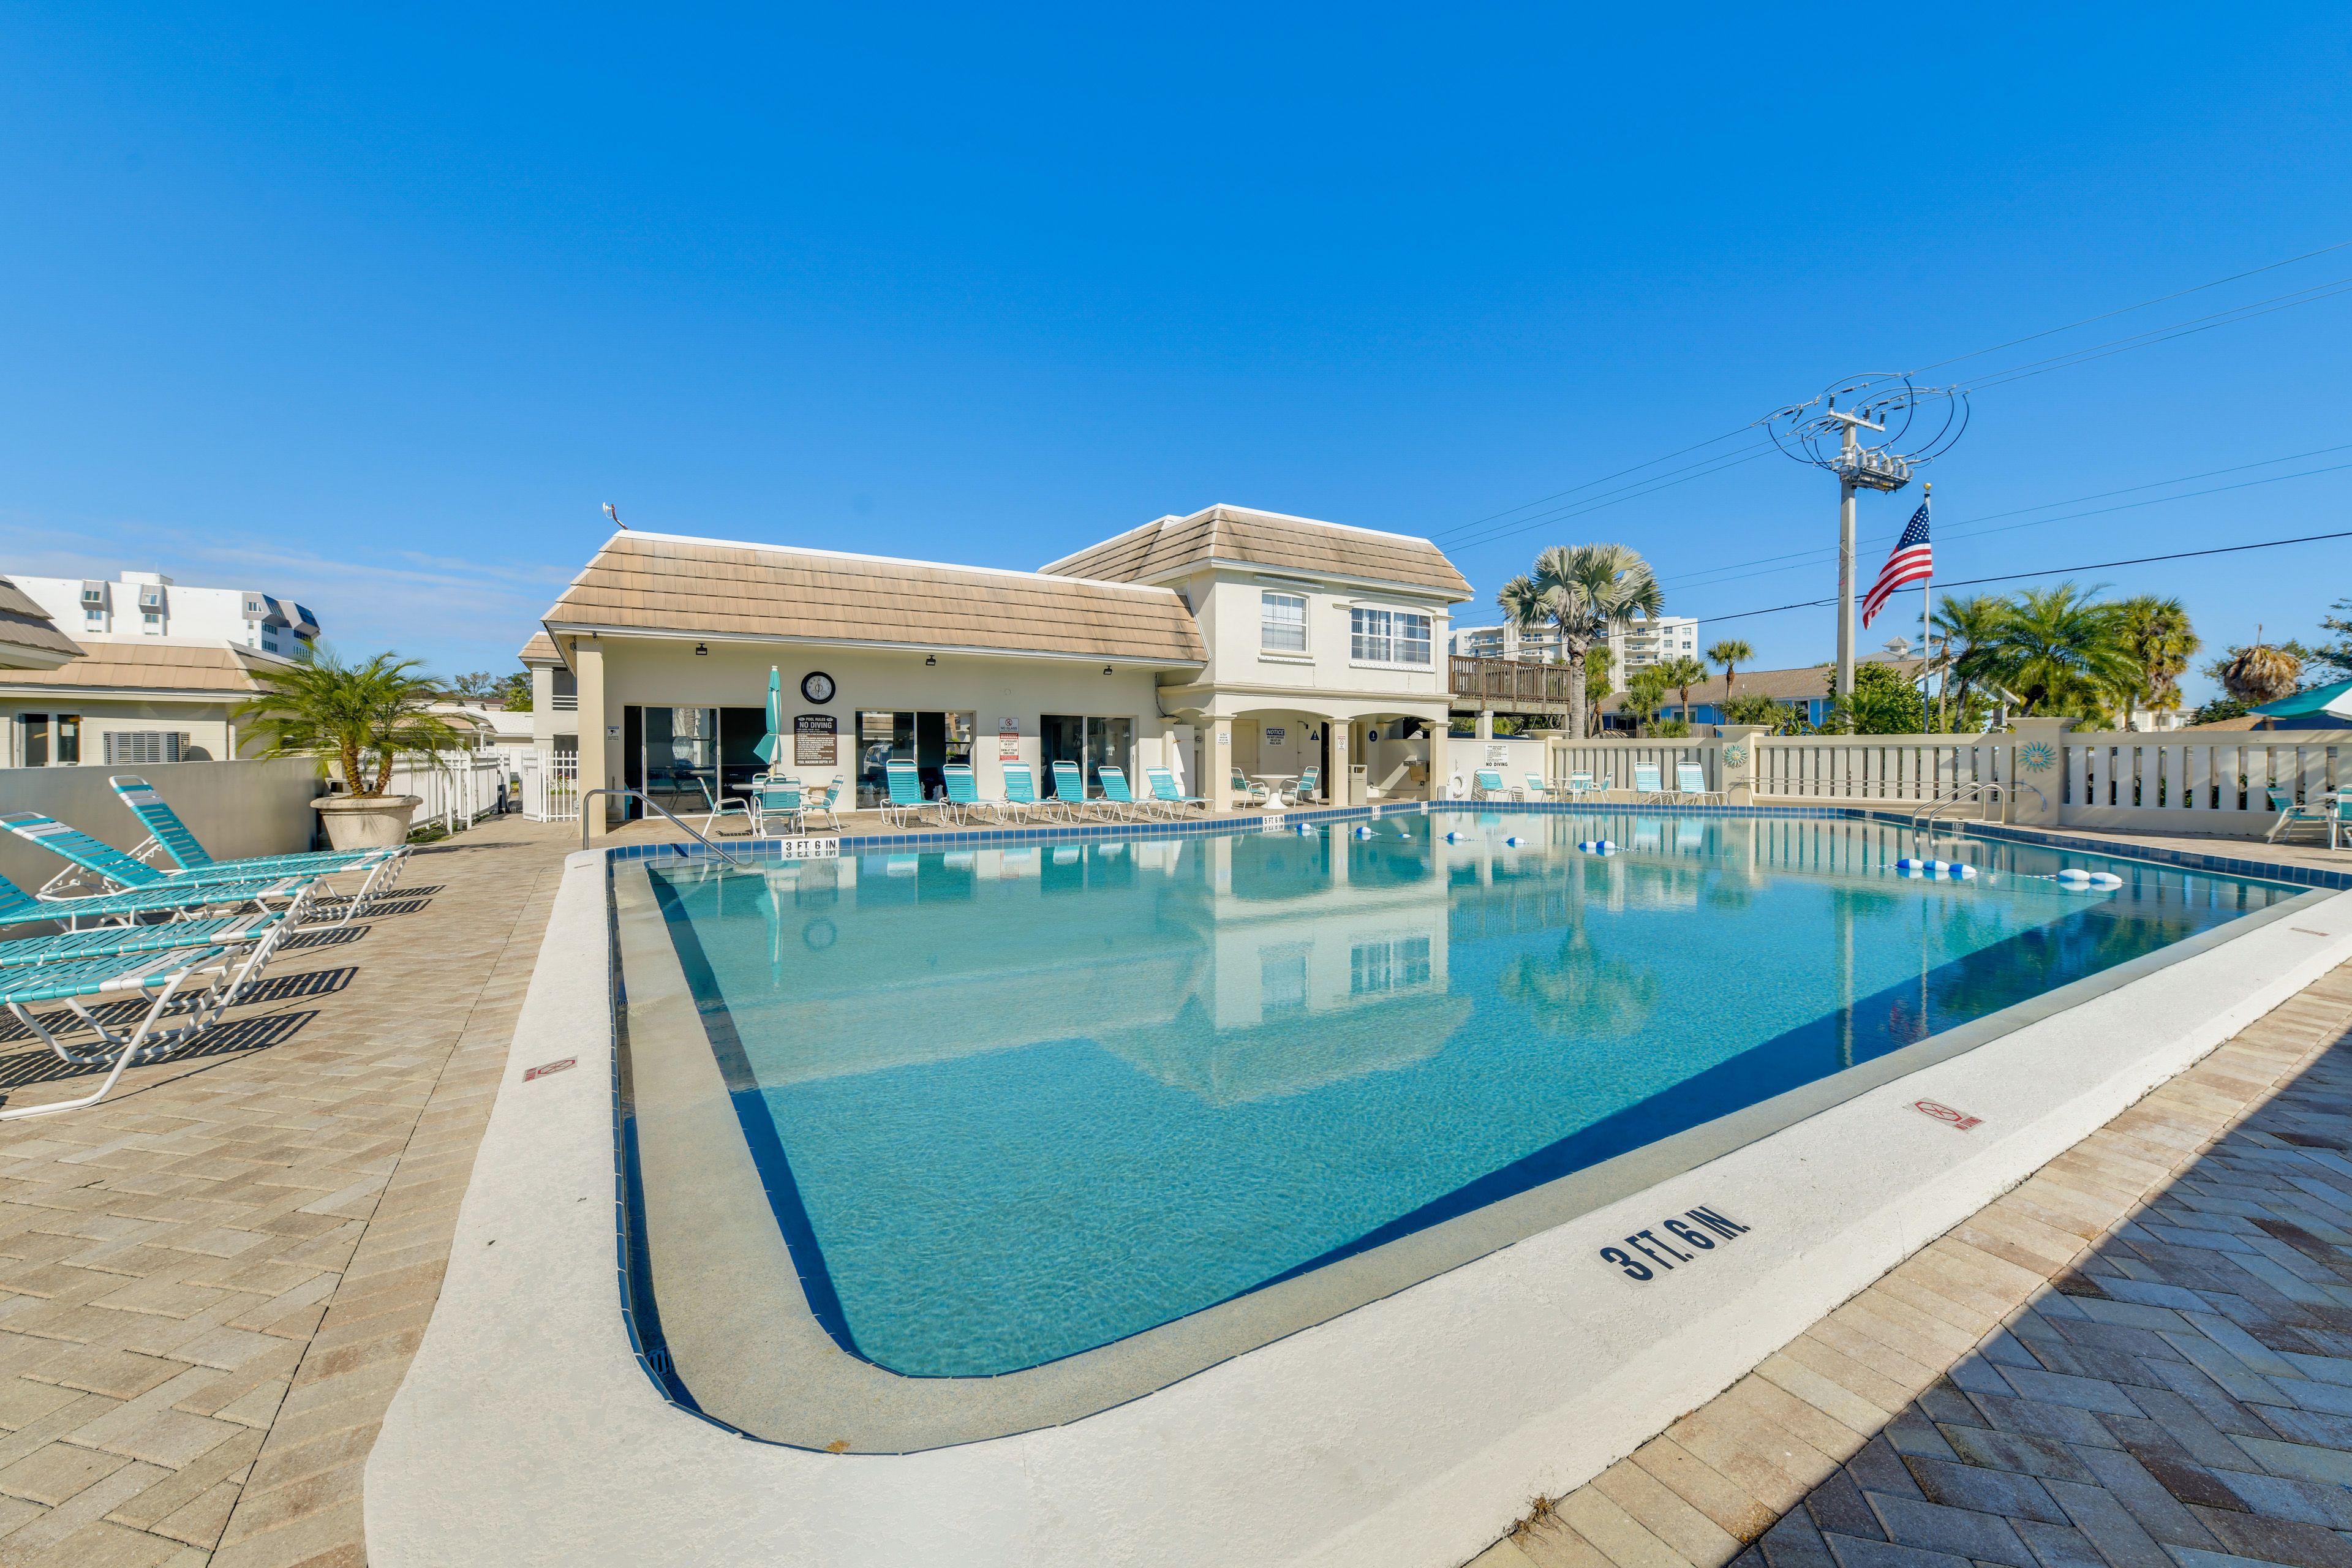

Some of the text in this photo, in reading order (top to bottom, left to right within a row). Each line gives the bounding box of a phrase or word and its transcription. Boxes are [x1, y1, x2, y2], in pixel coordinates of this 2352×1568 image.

[786, 842, 792, 851] 3
[815, 840, 821, 850] 6
[826, 840, 838, 849] IN.
[1600, 1205, 1751, 1281] 3 FT. 6 IN.
